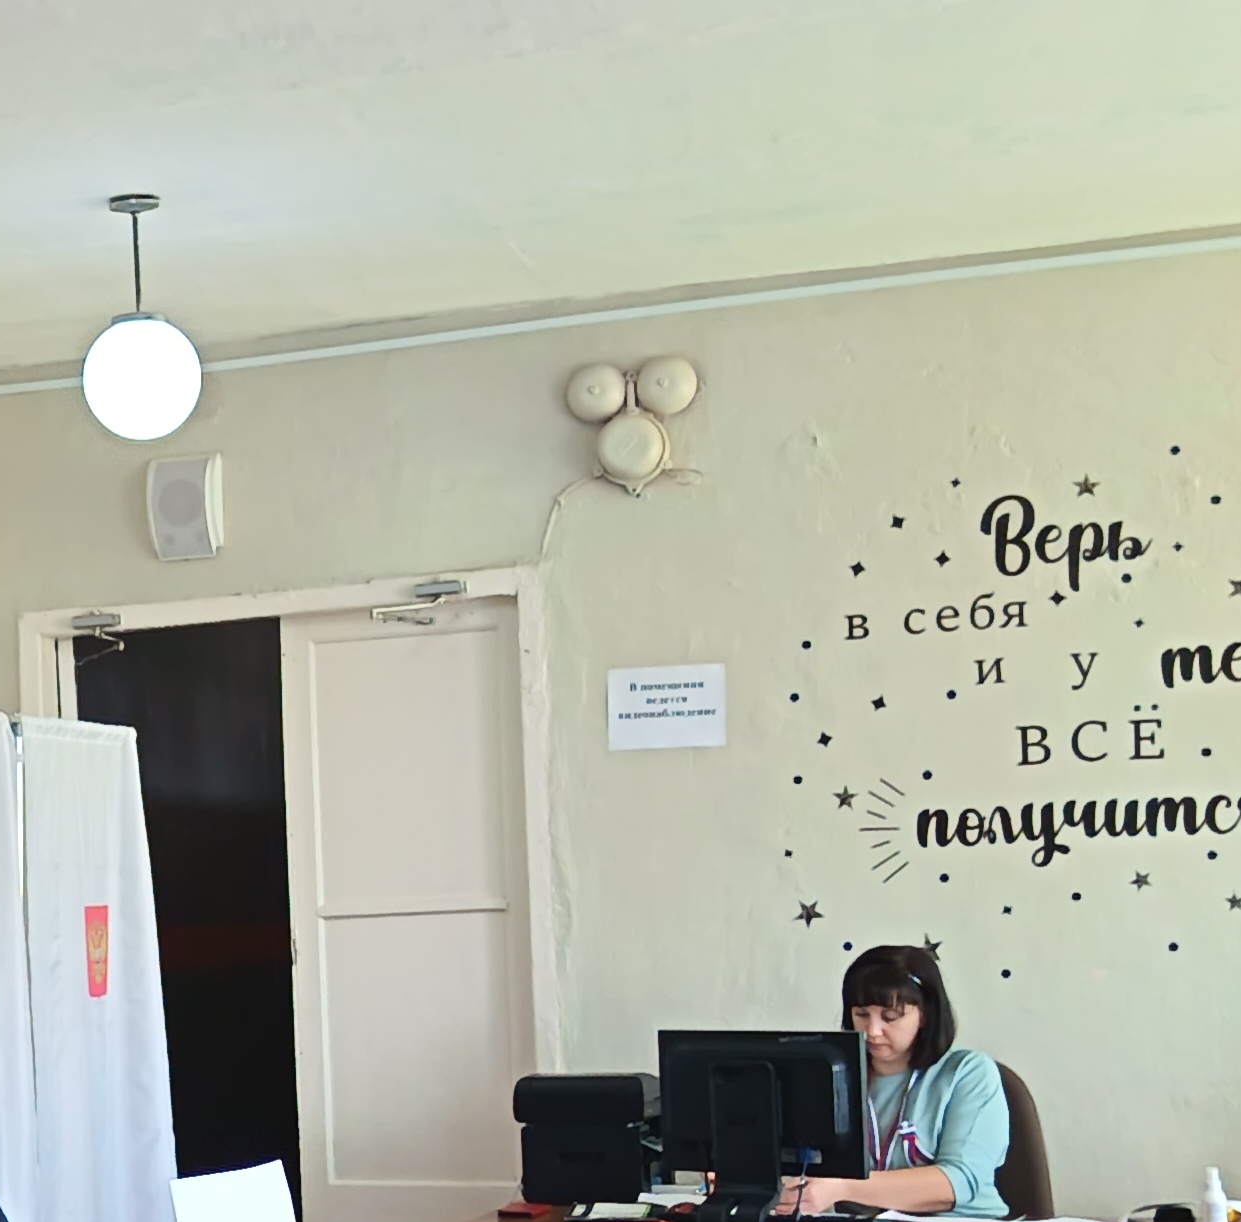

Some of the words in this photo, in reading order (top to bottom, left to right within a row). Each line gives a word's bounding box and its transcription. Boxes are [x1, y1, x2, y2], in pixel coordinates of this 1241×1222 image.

[979, 494, 1153, 593] Верь
[844, 614, 870, 640] в
[903, 592, 1029, 634] себя
[629, 682, 637, 692] В
[974, 656, 1006, 685] и
[1070, 651, 1099, 691] у
[1015, 703, 1165, 767] ВСЁ
[916, 794, 1241, 869] получитс
